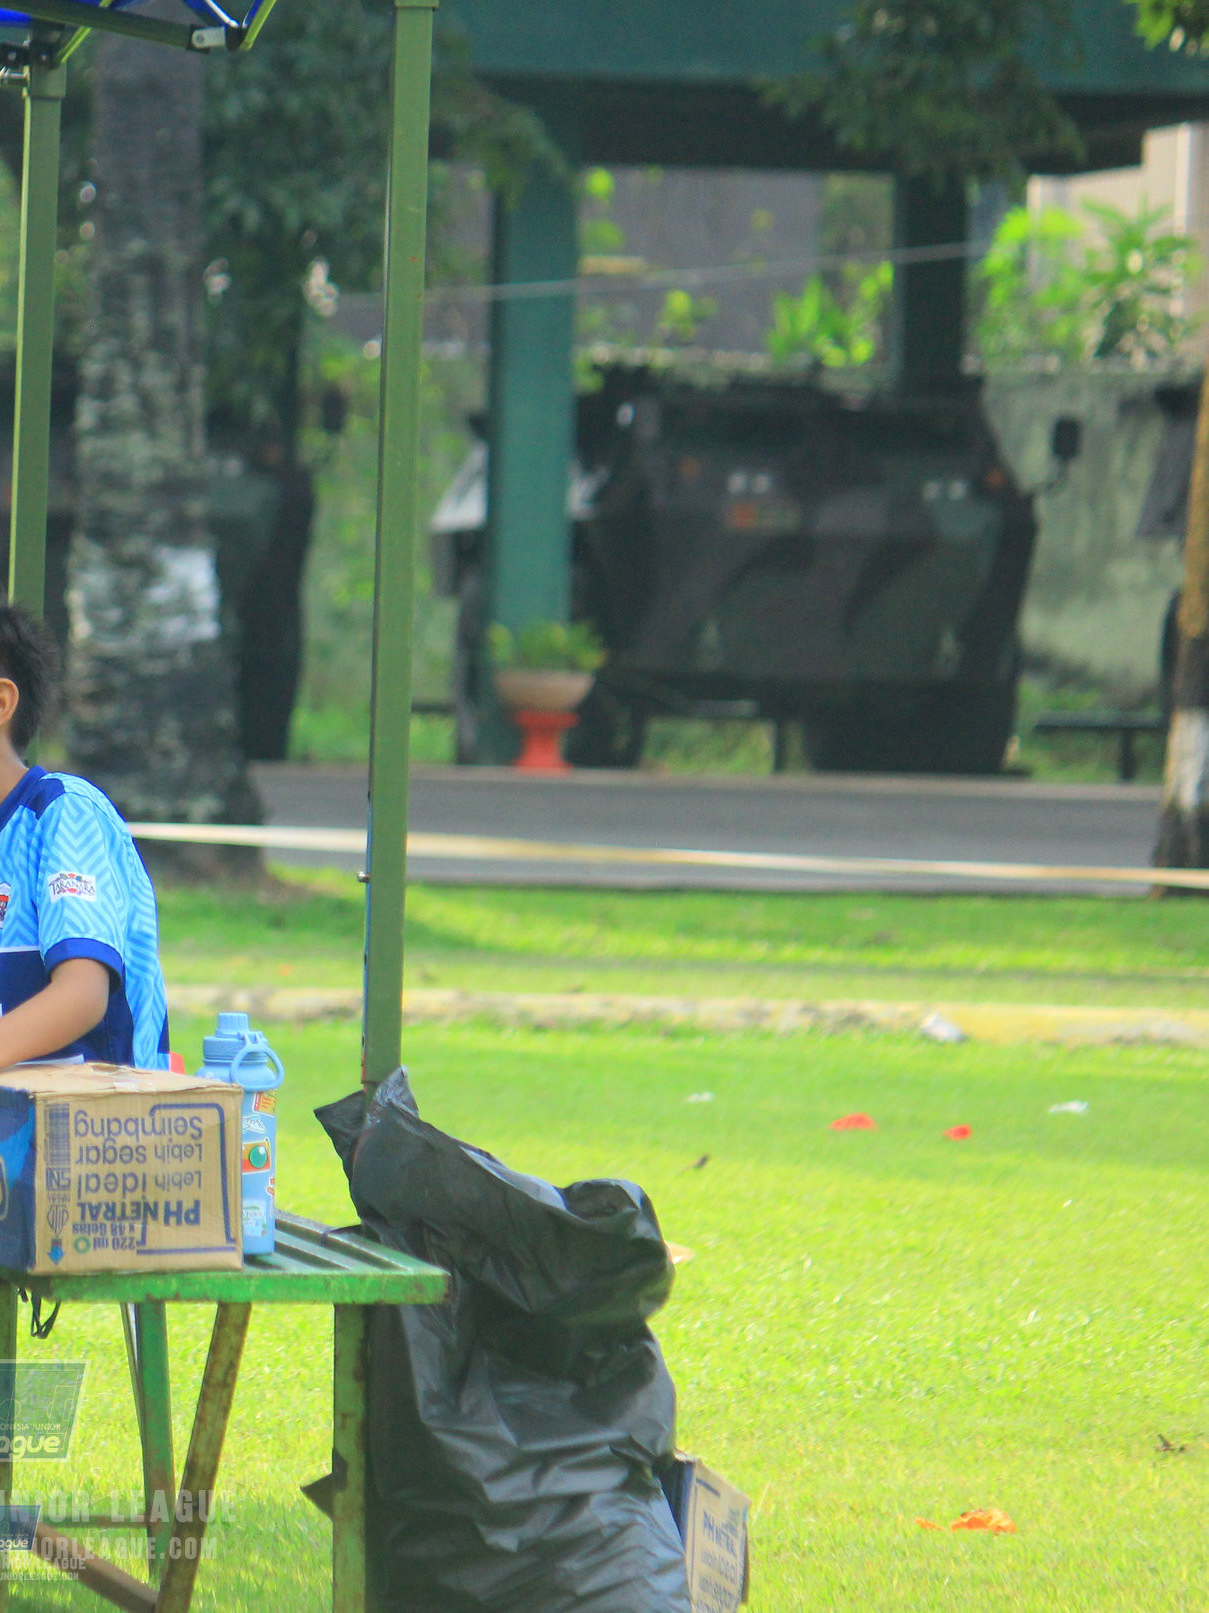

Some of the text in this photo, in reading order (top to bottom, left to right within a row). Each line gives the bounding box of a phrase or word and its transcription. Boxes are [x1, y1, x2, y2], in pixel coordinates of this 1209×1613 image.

[74, 1110, 203, 1143] Seimbang
[75, 1137, 202, 1166] Lebih segar
[77, 1170, 202, 1200] Lebih ideal
[76, 1199, 201, 1226] PH NETRAL
[112, 1237, 135, 1250] 220
